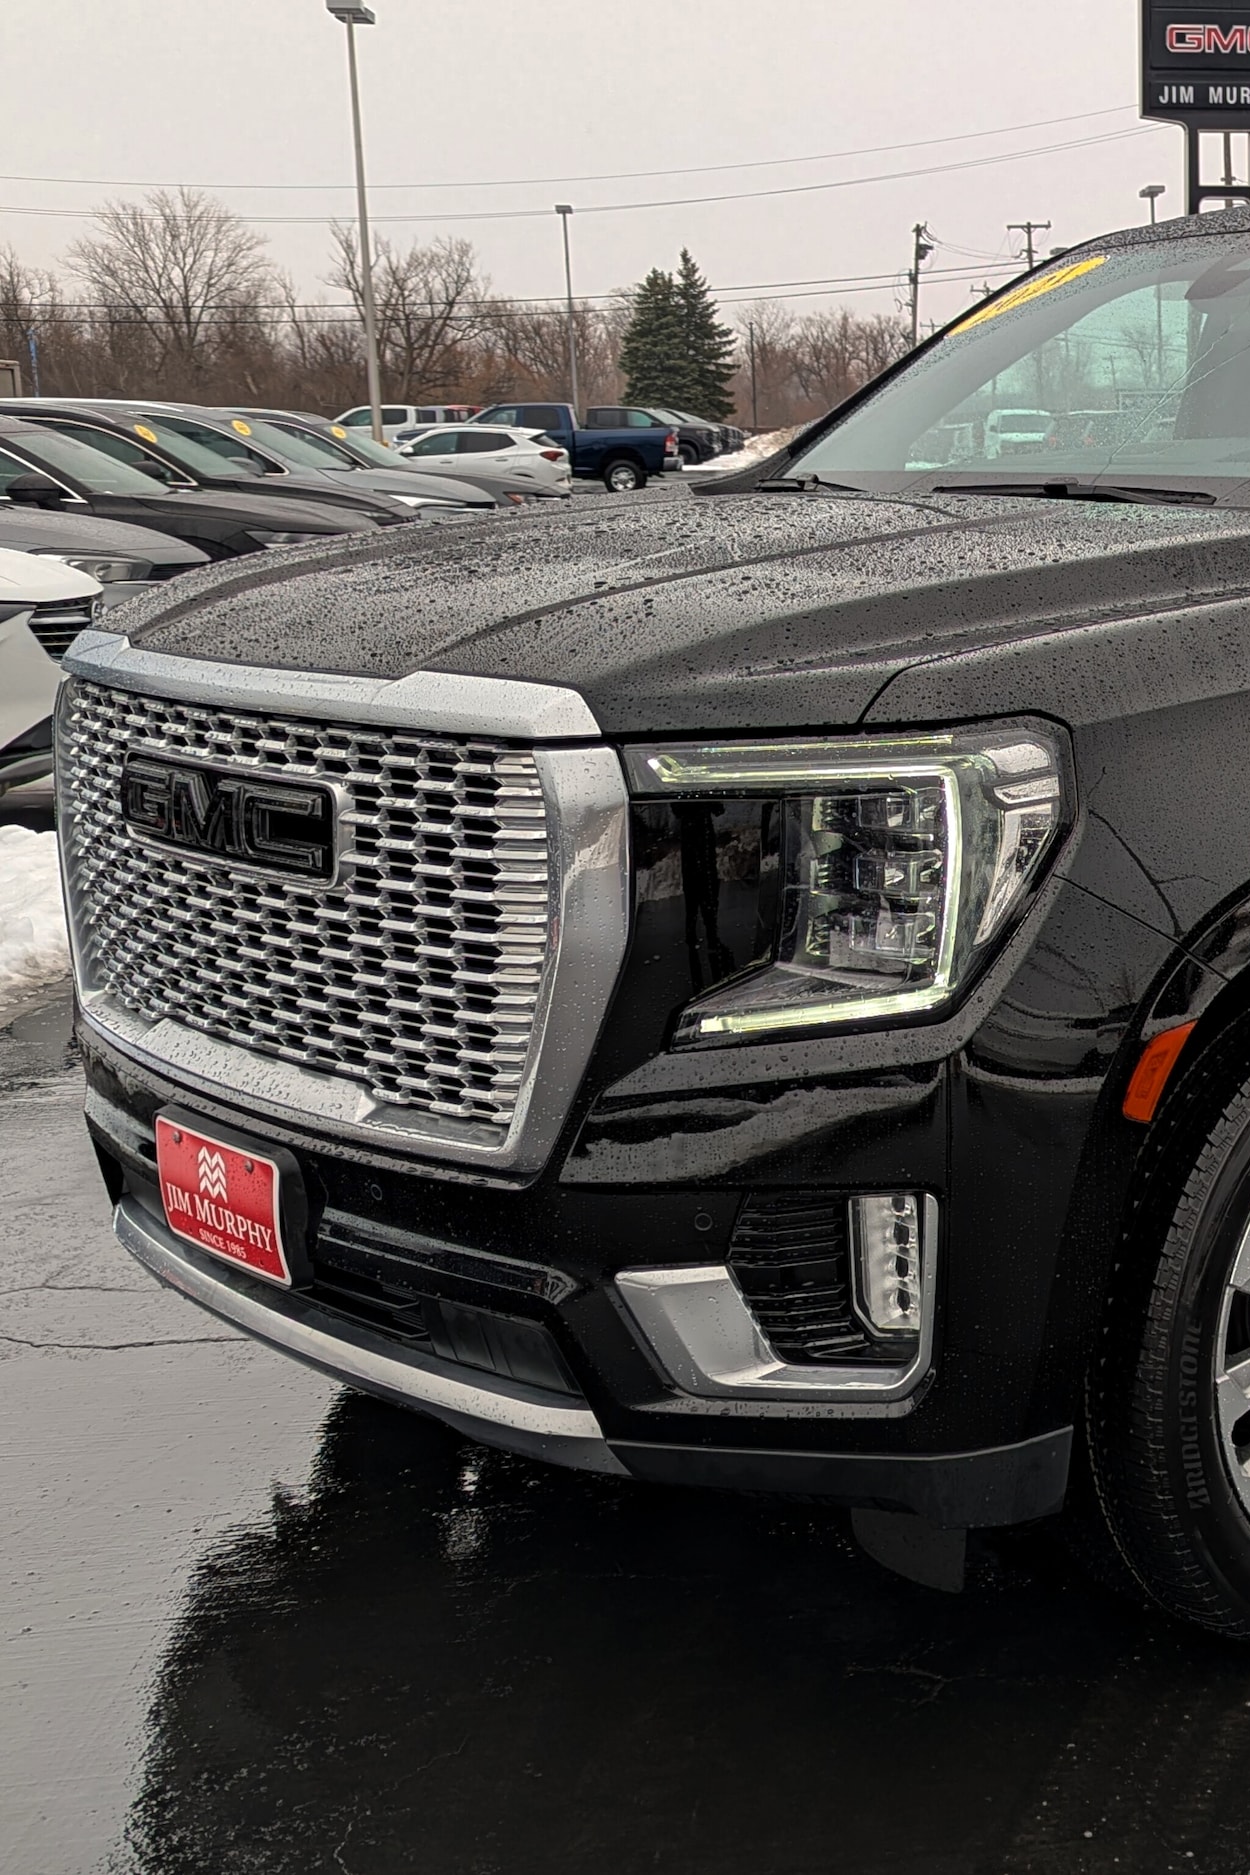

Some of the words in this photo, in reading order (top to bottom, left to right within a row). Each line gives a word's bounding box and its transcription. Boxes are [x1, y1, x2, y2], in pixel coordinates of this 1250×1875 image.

[1159, 85, 1194, 104] JIM
[122, 759, 326, 871] GMC
[166, 1182, 193, 1217] JIM
[193, 1194, 272, 1252] MURPHY
[198, 1227, 226, 1250] SINCE
[226, 1239, 247, 1259] 1985
